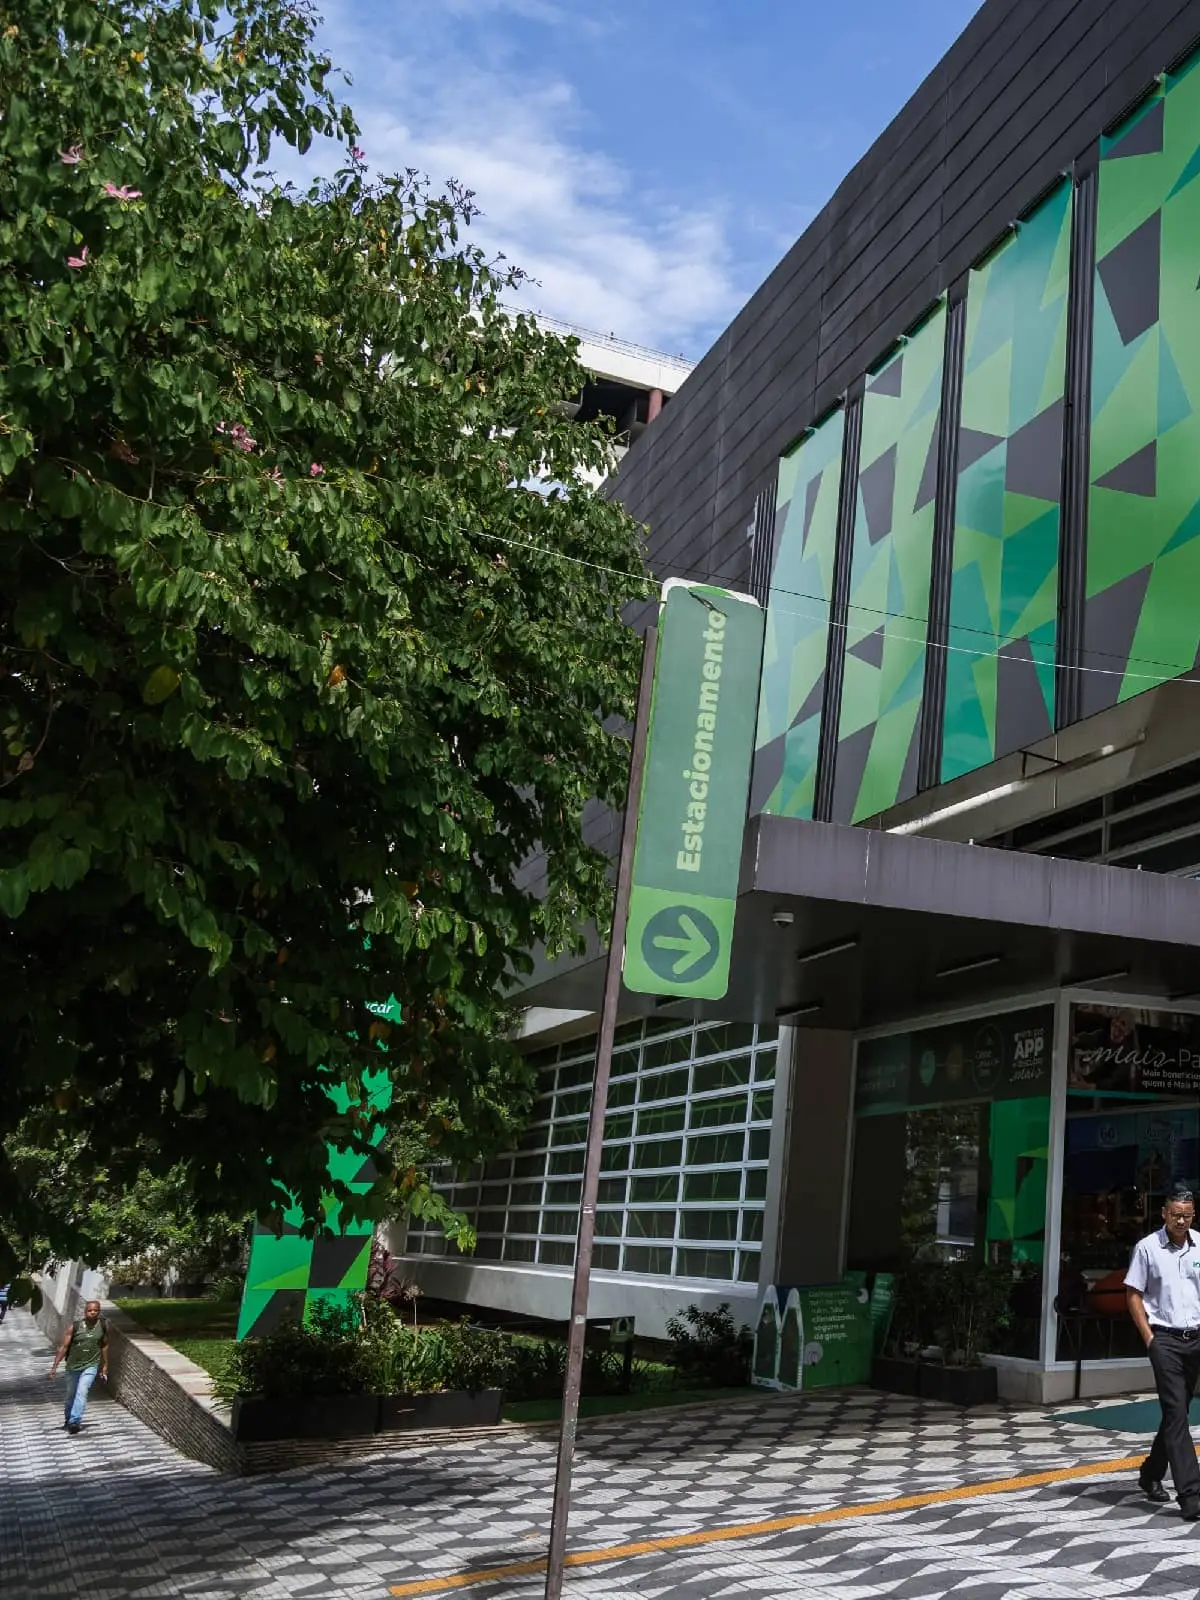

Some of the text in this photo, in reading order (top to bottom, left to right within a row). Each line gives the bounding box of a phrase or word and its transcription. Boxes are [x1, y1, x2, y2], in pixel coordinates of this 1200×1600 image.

[676, 608, 728, 872] Estacionamento
[1013, 1036, 1044, 1060] APP
[1082, 1045, 1175, 1068] mais
[1142, 1068, 1161, 1077] Mais
[1141, 1079, 1165, 1089] quem
[1173, 1081, 1191, 1090] Mais
